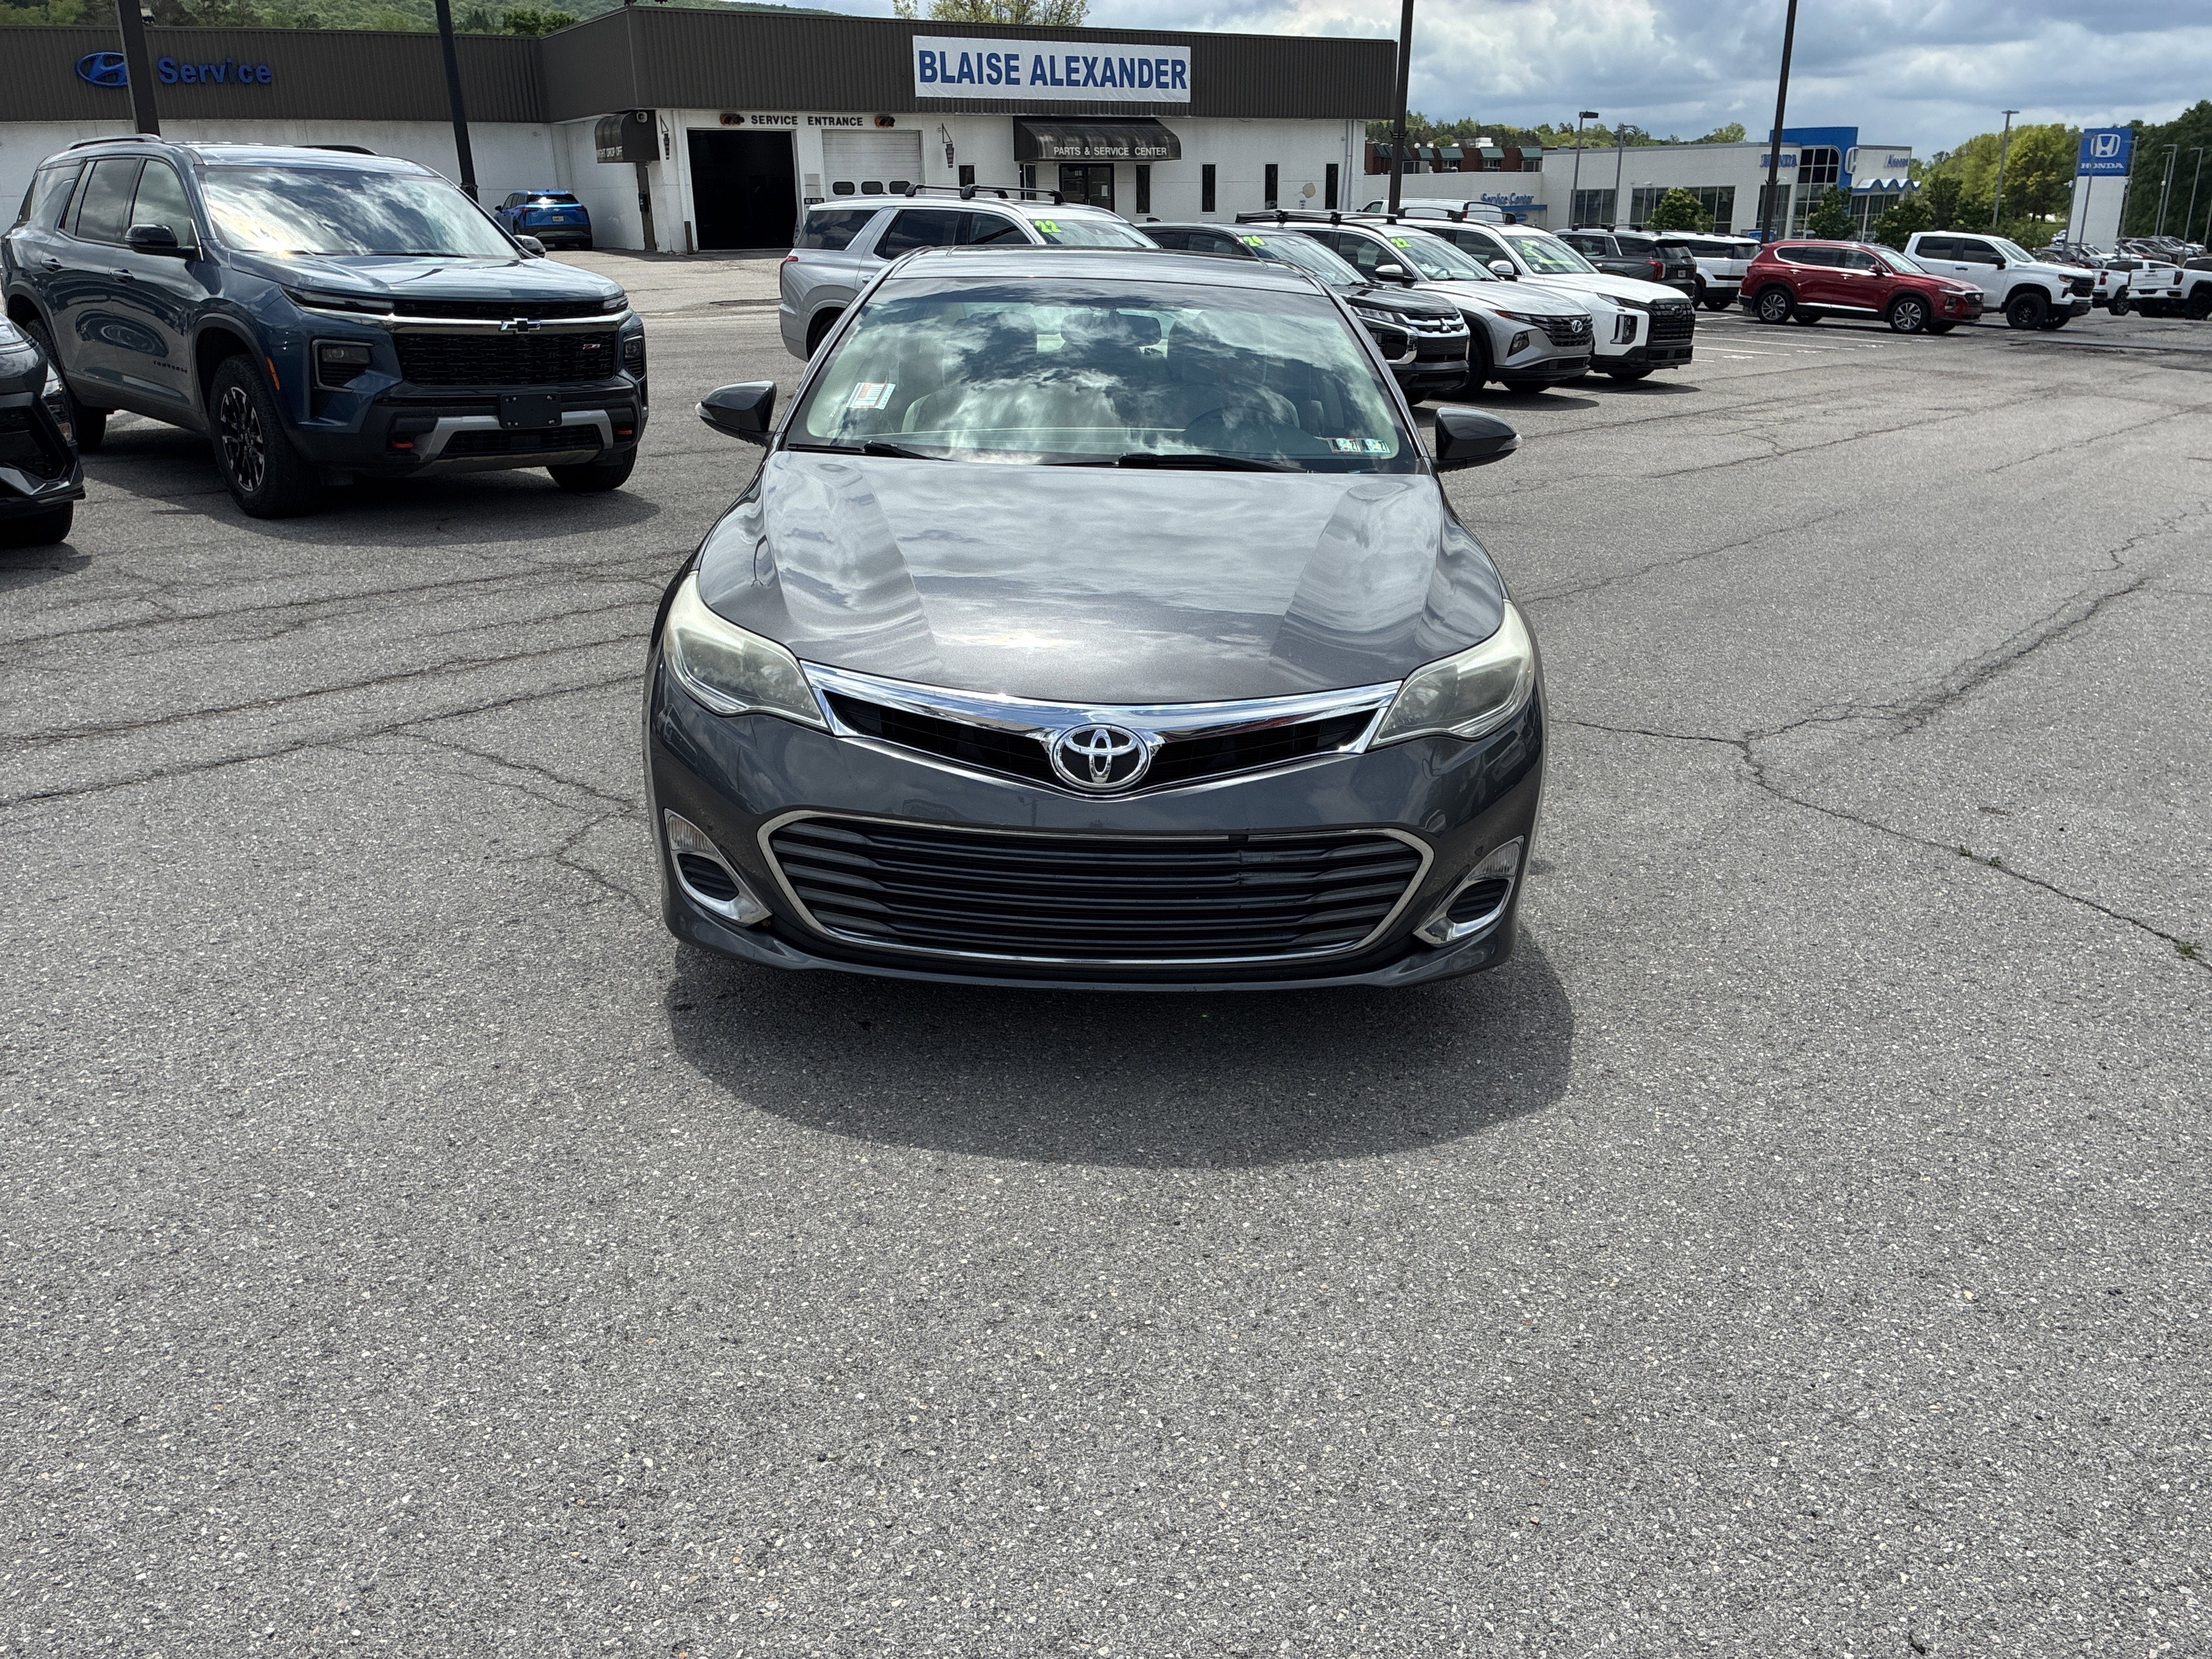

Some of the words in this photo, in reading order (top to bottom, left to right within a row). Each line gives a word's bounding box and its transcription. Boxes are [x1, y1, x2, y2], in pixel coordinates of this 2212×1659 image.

[157, 57, 272, 83] Service
[918, 50, 1020, 86] BLAISE
[1030, 54, 1187, 89] ALEXANDER
[751, 115, 798, 126] SERVICE
[808, 116, 864, 126] ENTRANCE
[1053, 146, 1081, 156] PARTS
[1084, 146, 1091, 156] &
[1094, 146, 1130, 156] SERVICE
[1135, 147, 1167, 156] CENTER
[1481, 193, 1508, 205] Service
[1509, 193, 1534, 205] Center
[1035, 220, 1062, 233] 22
[1390, 238, 1412, 248] 22
